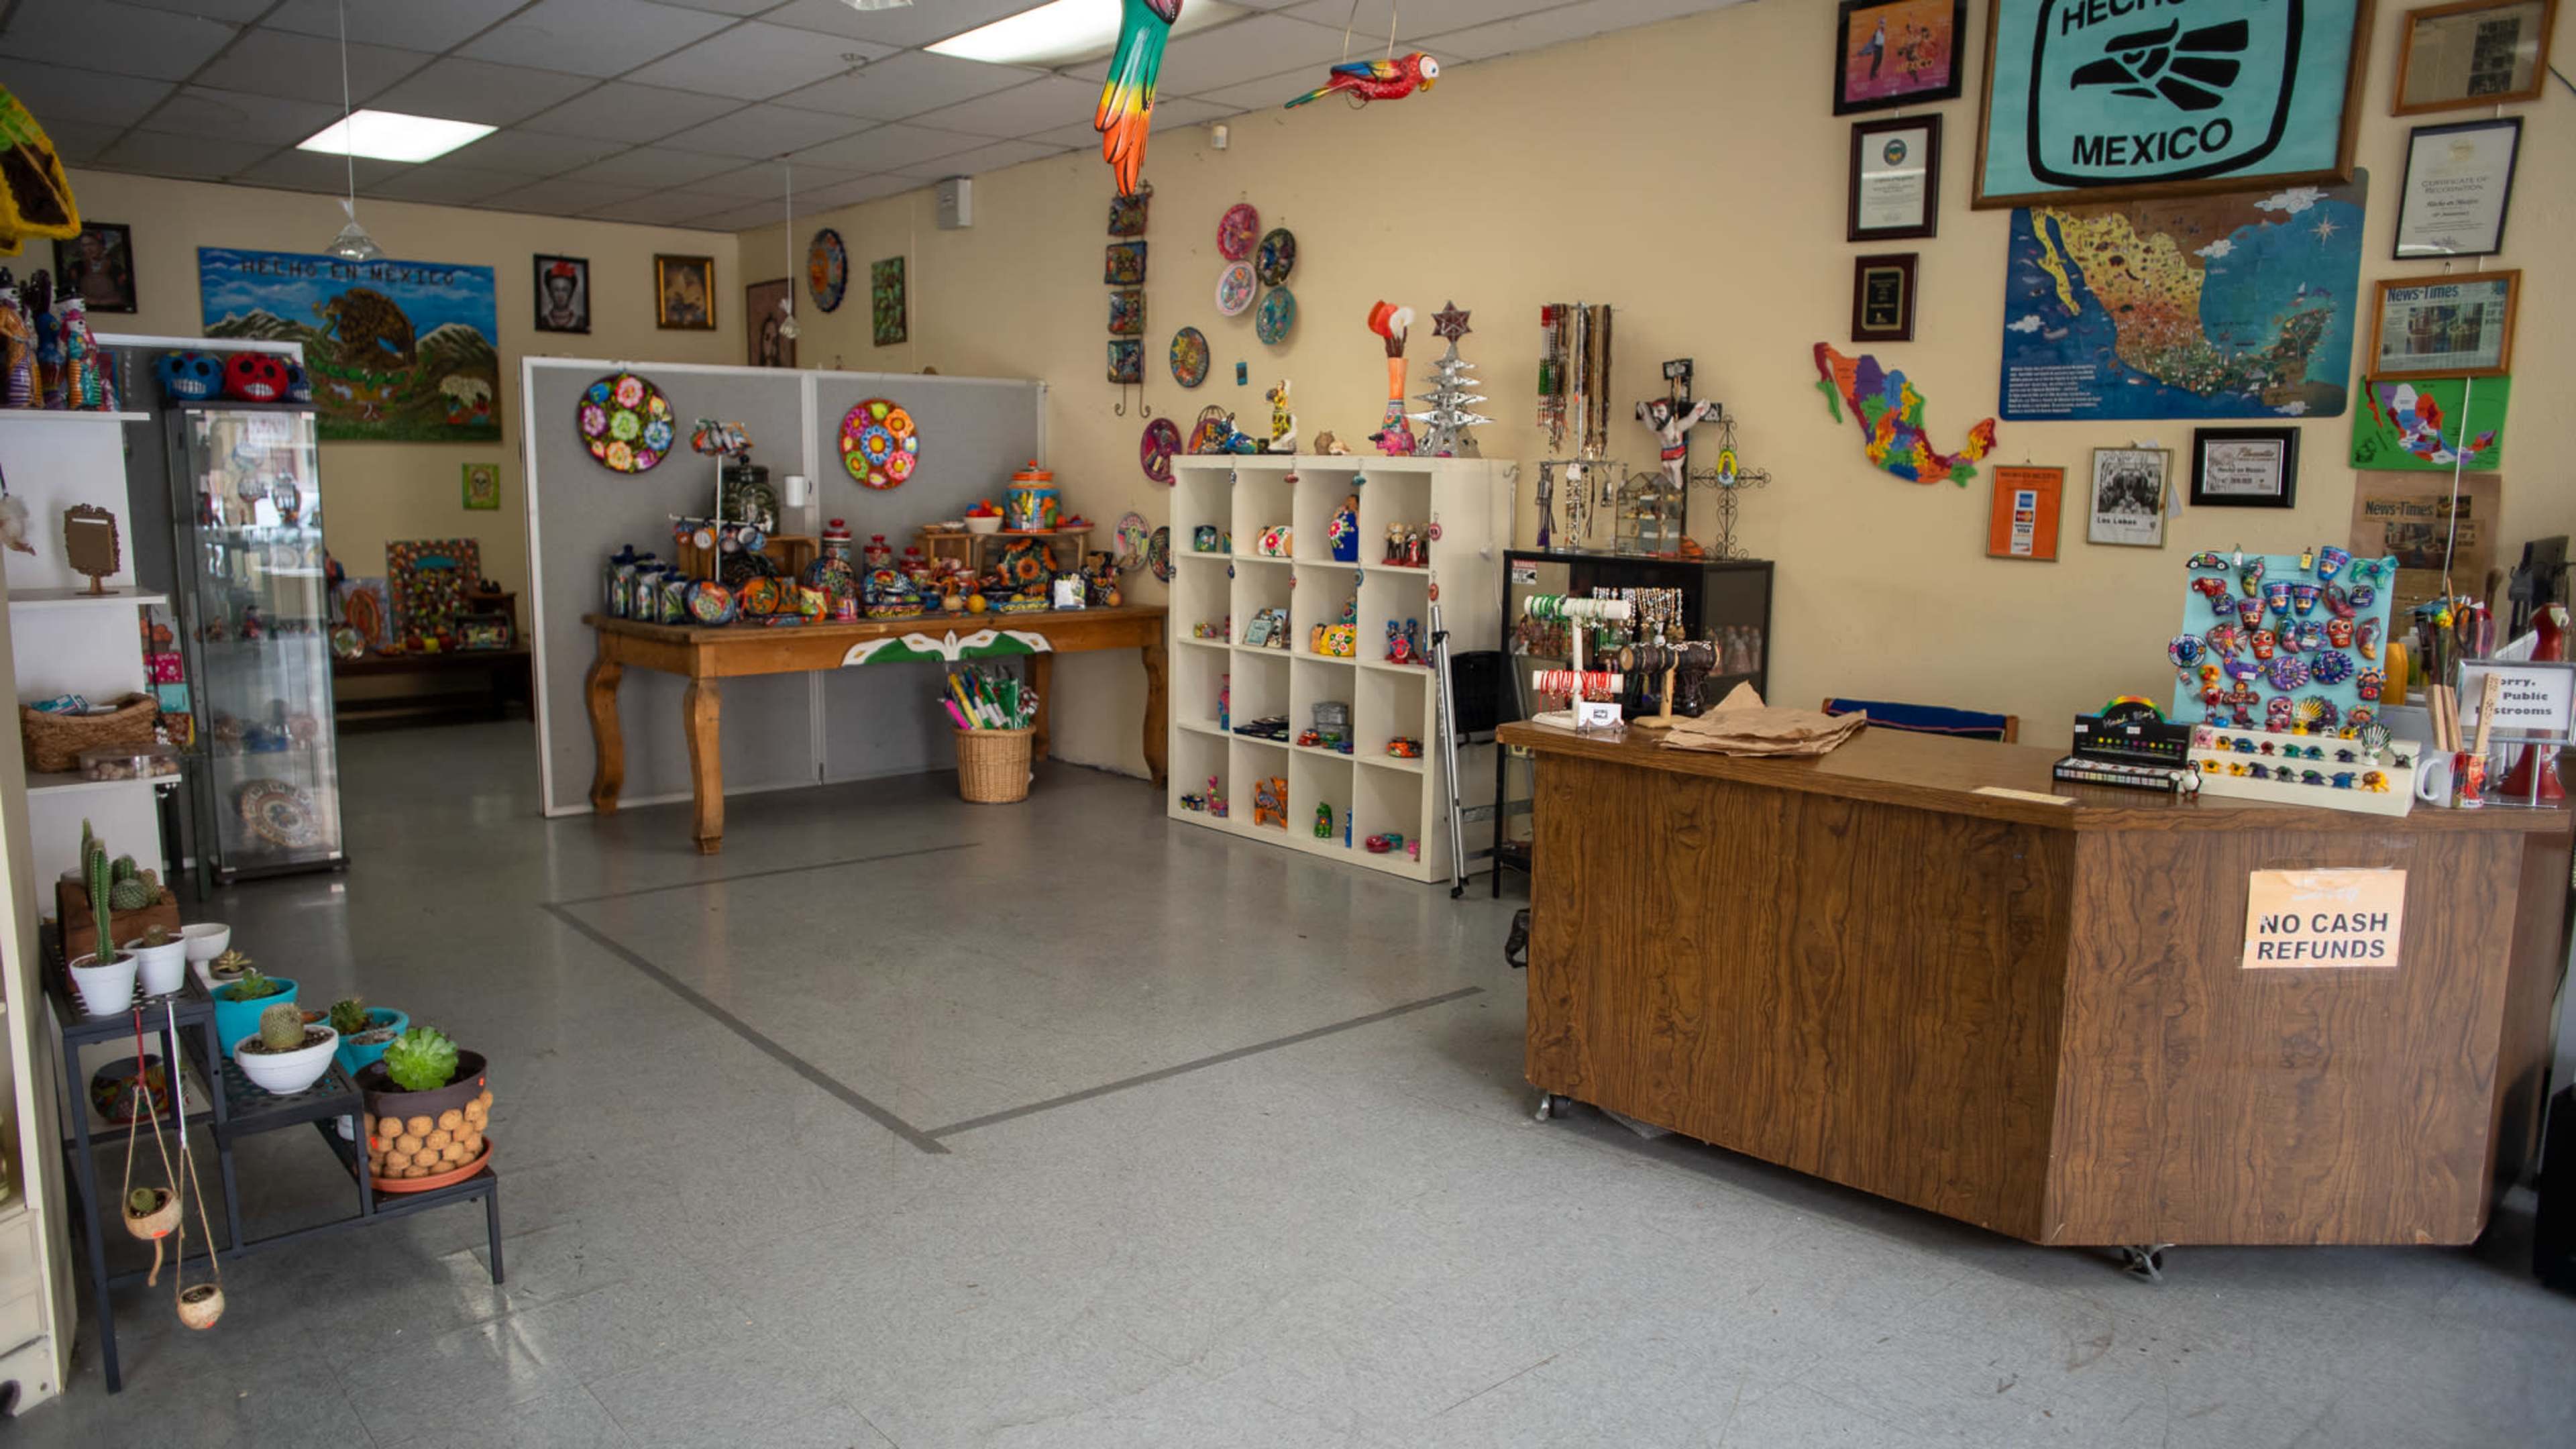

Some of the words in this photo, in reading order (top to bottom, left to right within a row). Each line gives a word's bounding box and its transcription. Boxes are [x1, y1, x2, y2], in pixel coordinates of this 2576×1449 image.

[2061, 0, 2181, 36] HEC
[2072, 118, 2233, 166] MEXICO
[2421, 176, 2474, 188] CERTIFICATE
[2476, 174, 2490, 182] OF
[2425, 184, 2483, 193] RECOGNITION
[241, 258, 317, 278] HECHO
[331, 262, 357, 280] EN
[2387, 284, 2459, 302] News-Times
[2365, 501, 2435, 516] News-Times
[2501, 678, 2536, 687] orry.
[2503, 692, 2548, 700] Public
[2475, 706, 2552, 715] strooms
[2259, 914, 2300, 934] NO
[2311, 912, 2388, 933] CASH
[2257, 939, 2385, 960] REFUNDS
